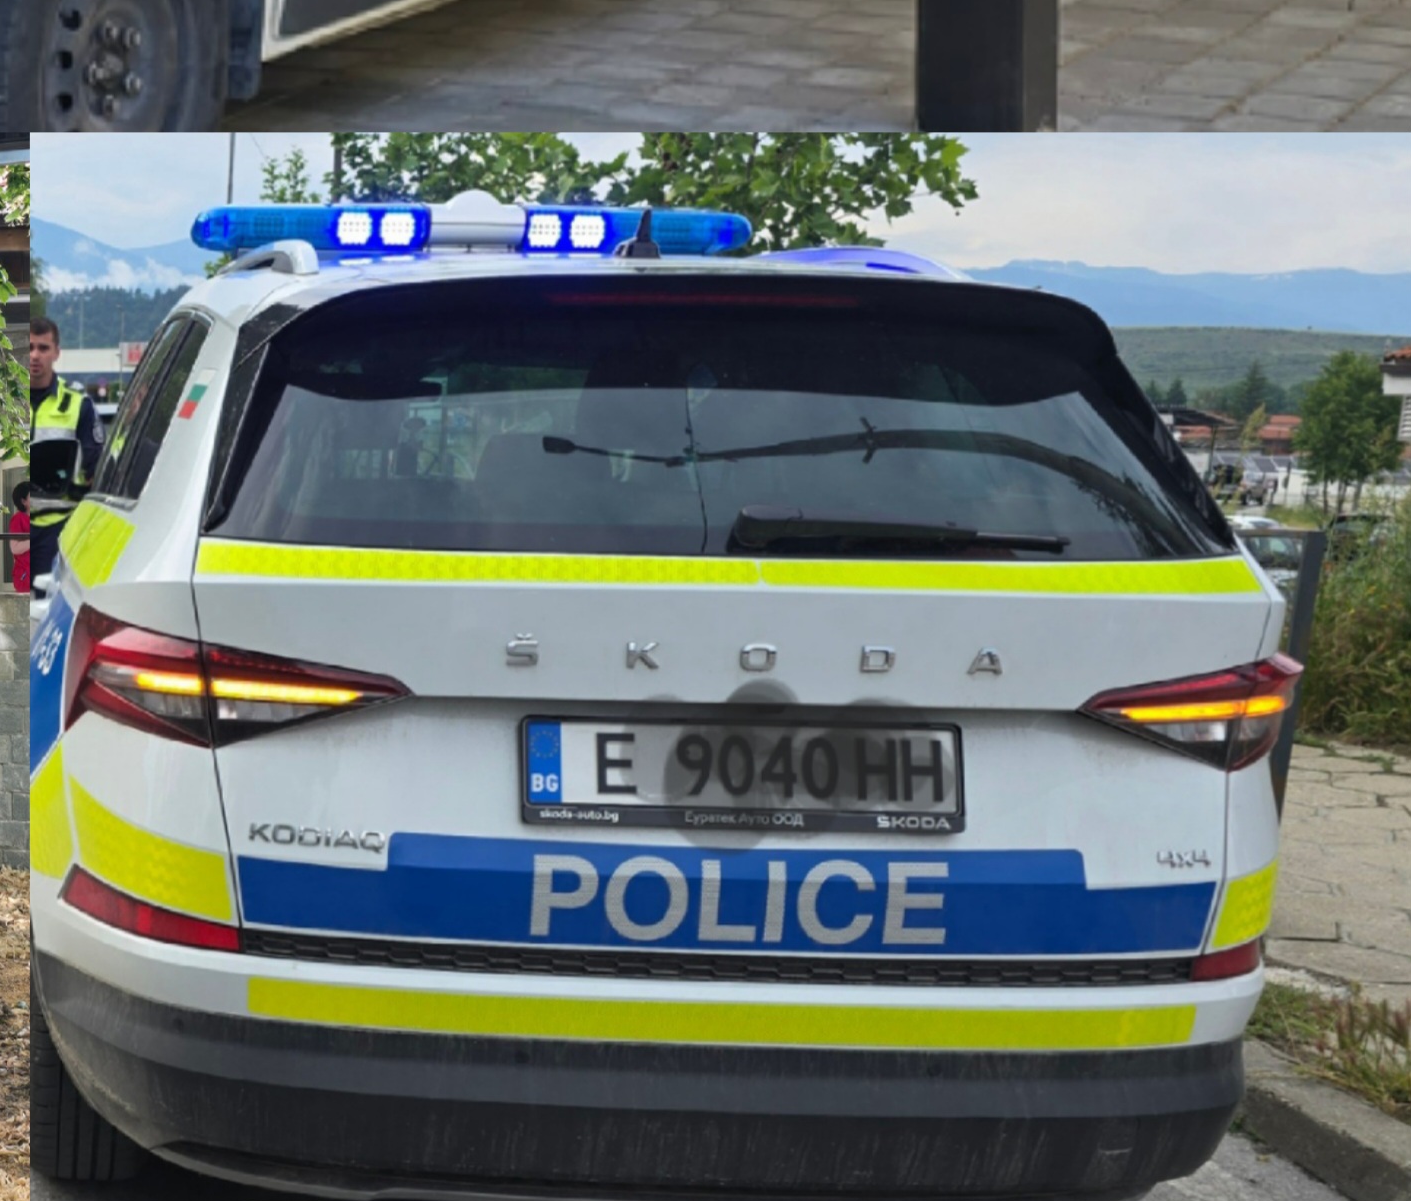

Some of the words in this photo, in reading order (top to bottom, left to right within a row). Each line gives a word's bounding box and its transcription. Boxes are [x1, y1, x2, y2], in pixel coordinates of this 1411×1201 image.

[505, 633, 1004, 676] ŠKODA
[530, 774, 560, 793] BG
[596, 733, 638, 795] E
[676, 736, 840, 799] 9040
[856, 739, 946, 803] HH
[248, 823, 387, 854] KODIAQ
[529, 854, 950, 946] POLICE
